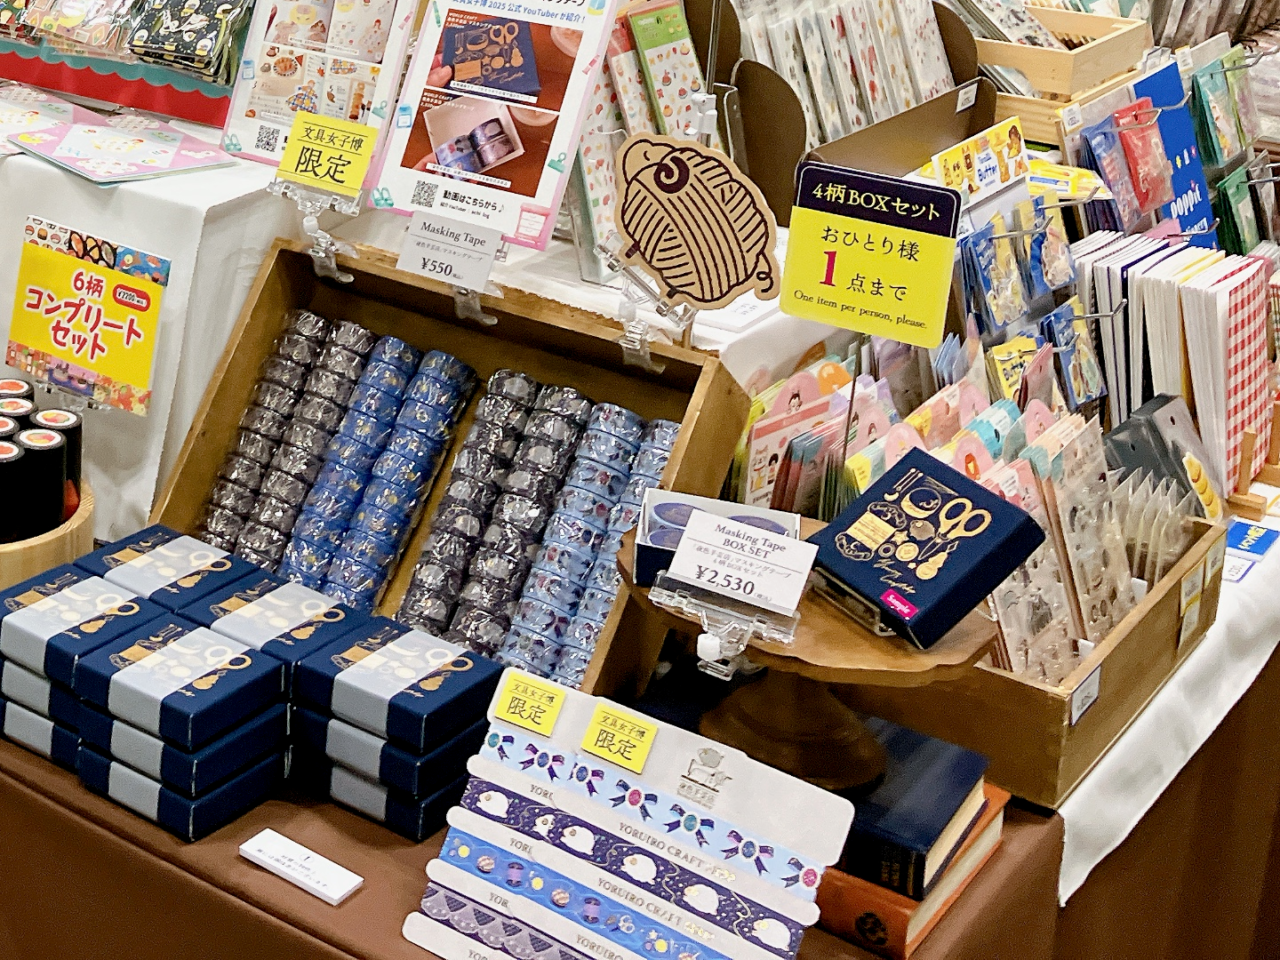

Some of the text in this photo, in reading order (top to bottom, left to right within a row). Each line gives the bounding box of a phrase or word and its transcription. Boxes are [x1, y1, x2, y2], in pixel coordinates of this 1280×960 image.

[488, 1, 506, 11] 2025
[523, 6, 558, 19] YouTuber
[302, 126, 364, 151] 文具女子博
[295, 145, 351, 184] 限定
[812, 182, 940, 221] 4柄BOXセット
[421, 221, 487, 246] Masking Tape
[821, 225, 921, 262] おひとり様
[421, 257, 453, 277] ¥550
[819, 250, 908, 301] 1 点まで
[73, 271, 104, 298] 6柄
[26, 288, 142, 346] コンプリート
[794, 289, 814, 303] One
[817, 296, 837, 309] item
[841, 303, 855, 317] per
[859, 307, 893, 322] person,
[52, 320, 106, 360] セット
[715, 523, 787, 552] Masking Tape
[722, 538, 771, 559] BOX SET
[695, 564, 755, 596] ¥2,530
[506, 696, 548, 726] 限定
[593, 729, 637, 761] 限定
